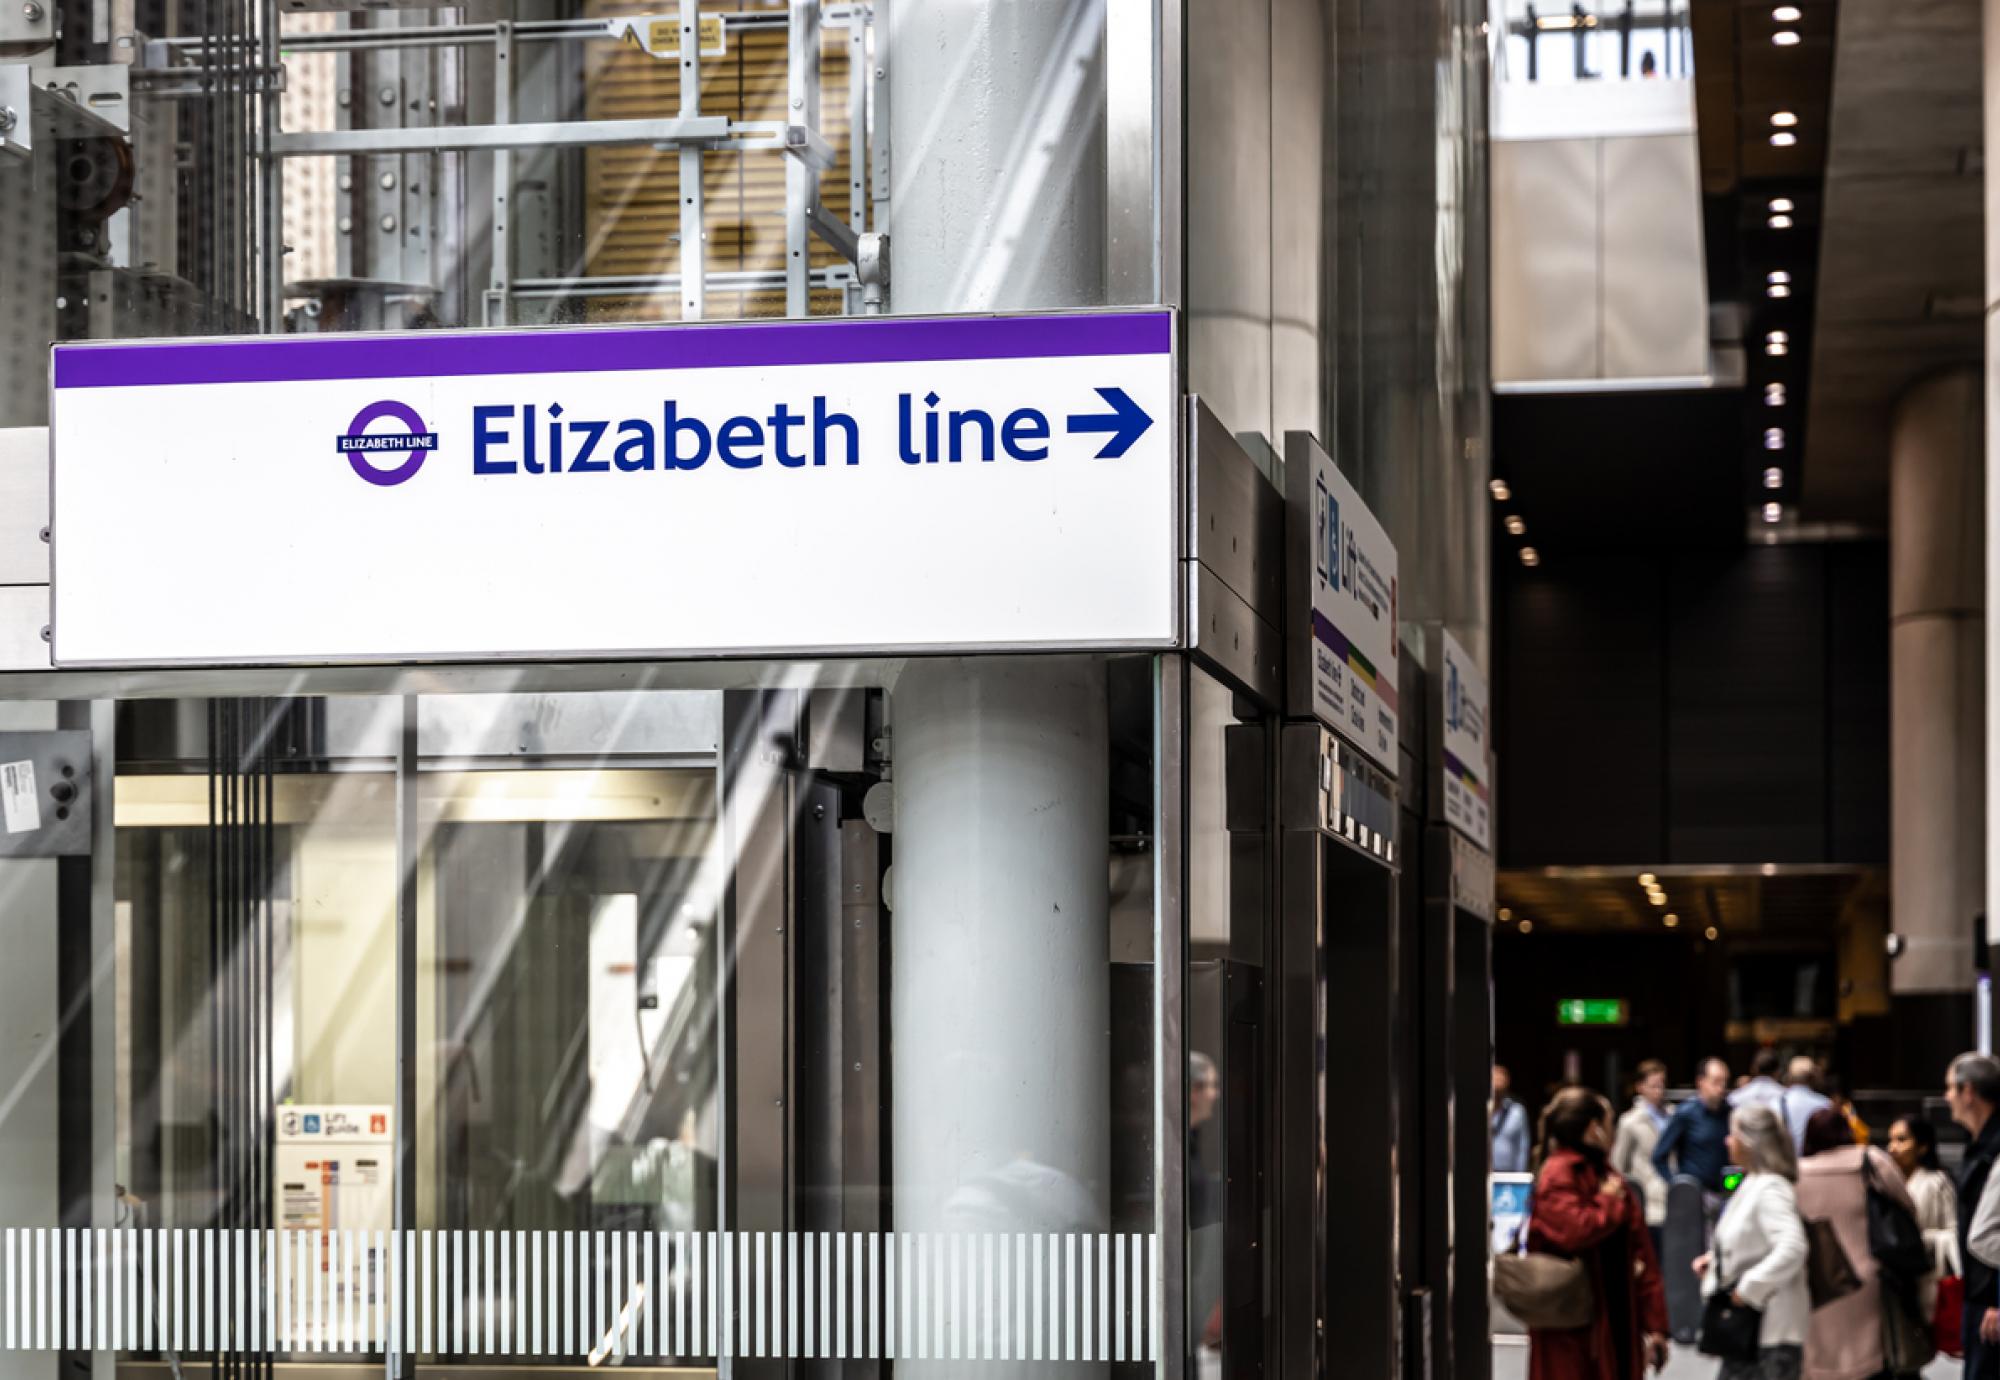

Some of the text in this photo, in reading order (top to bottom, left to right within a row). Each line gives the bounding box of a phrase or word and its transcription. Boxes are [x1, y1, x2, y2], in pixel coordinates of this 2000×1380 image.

[342, 436, 433, 449] ELIZABETH LINE
[473, 391, 1051, 475] Elizabeth line
